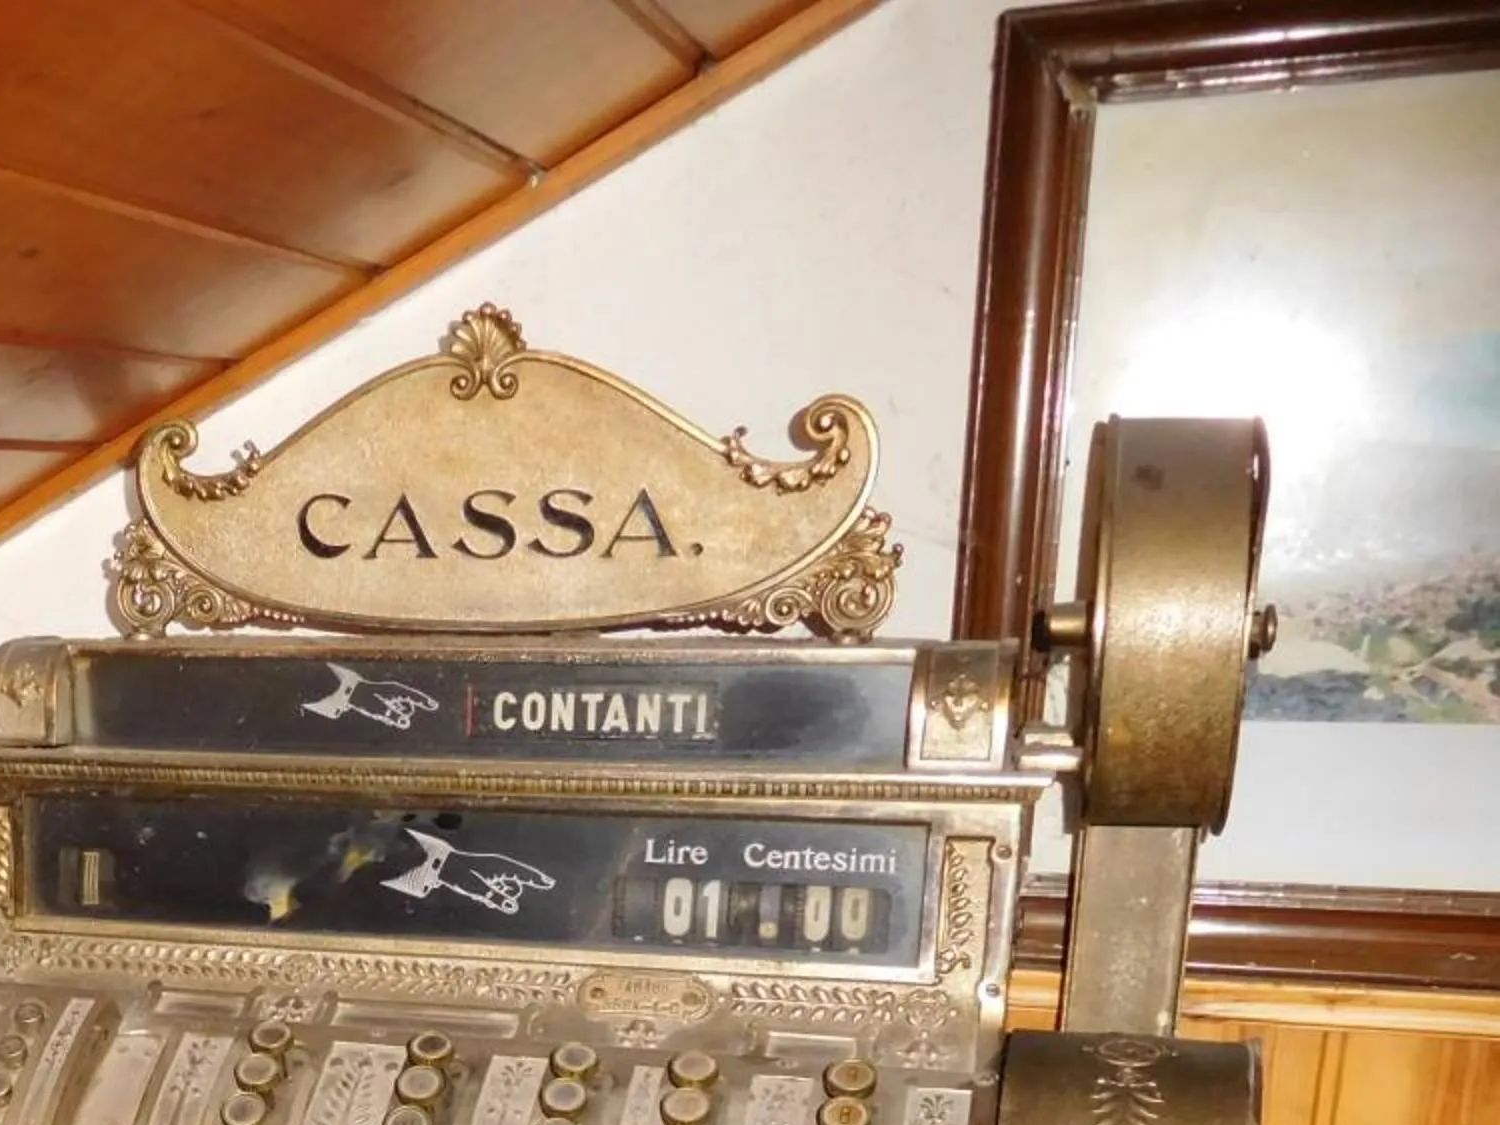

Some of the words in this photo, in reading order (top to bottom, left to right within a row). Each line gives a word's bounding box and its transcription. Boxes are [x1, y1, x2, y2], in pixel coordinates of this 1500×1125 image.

[296, 487, 705, 559] CASSA.
[493, 691, 709, 734] CONTANTI
[644, 838, 709, 866] Lire
[743, 843, 897, 874] Centesimi
